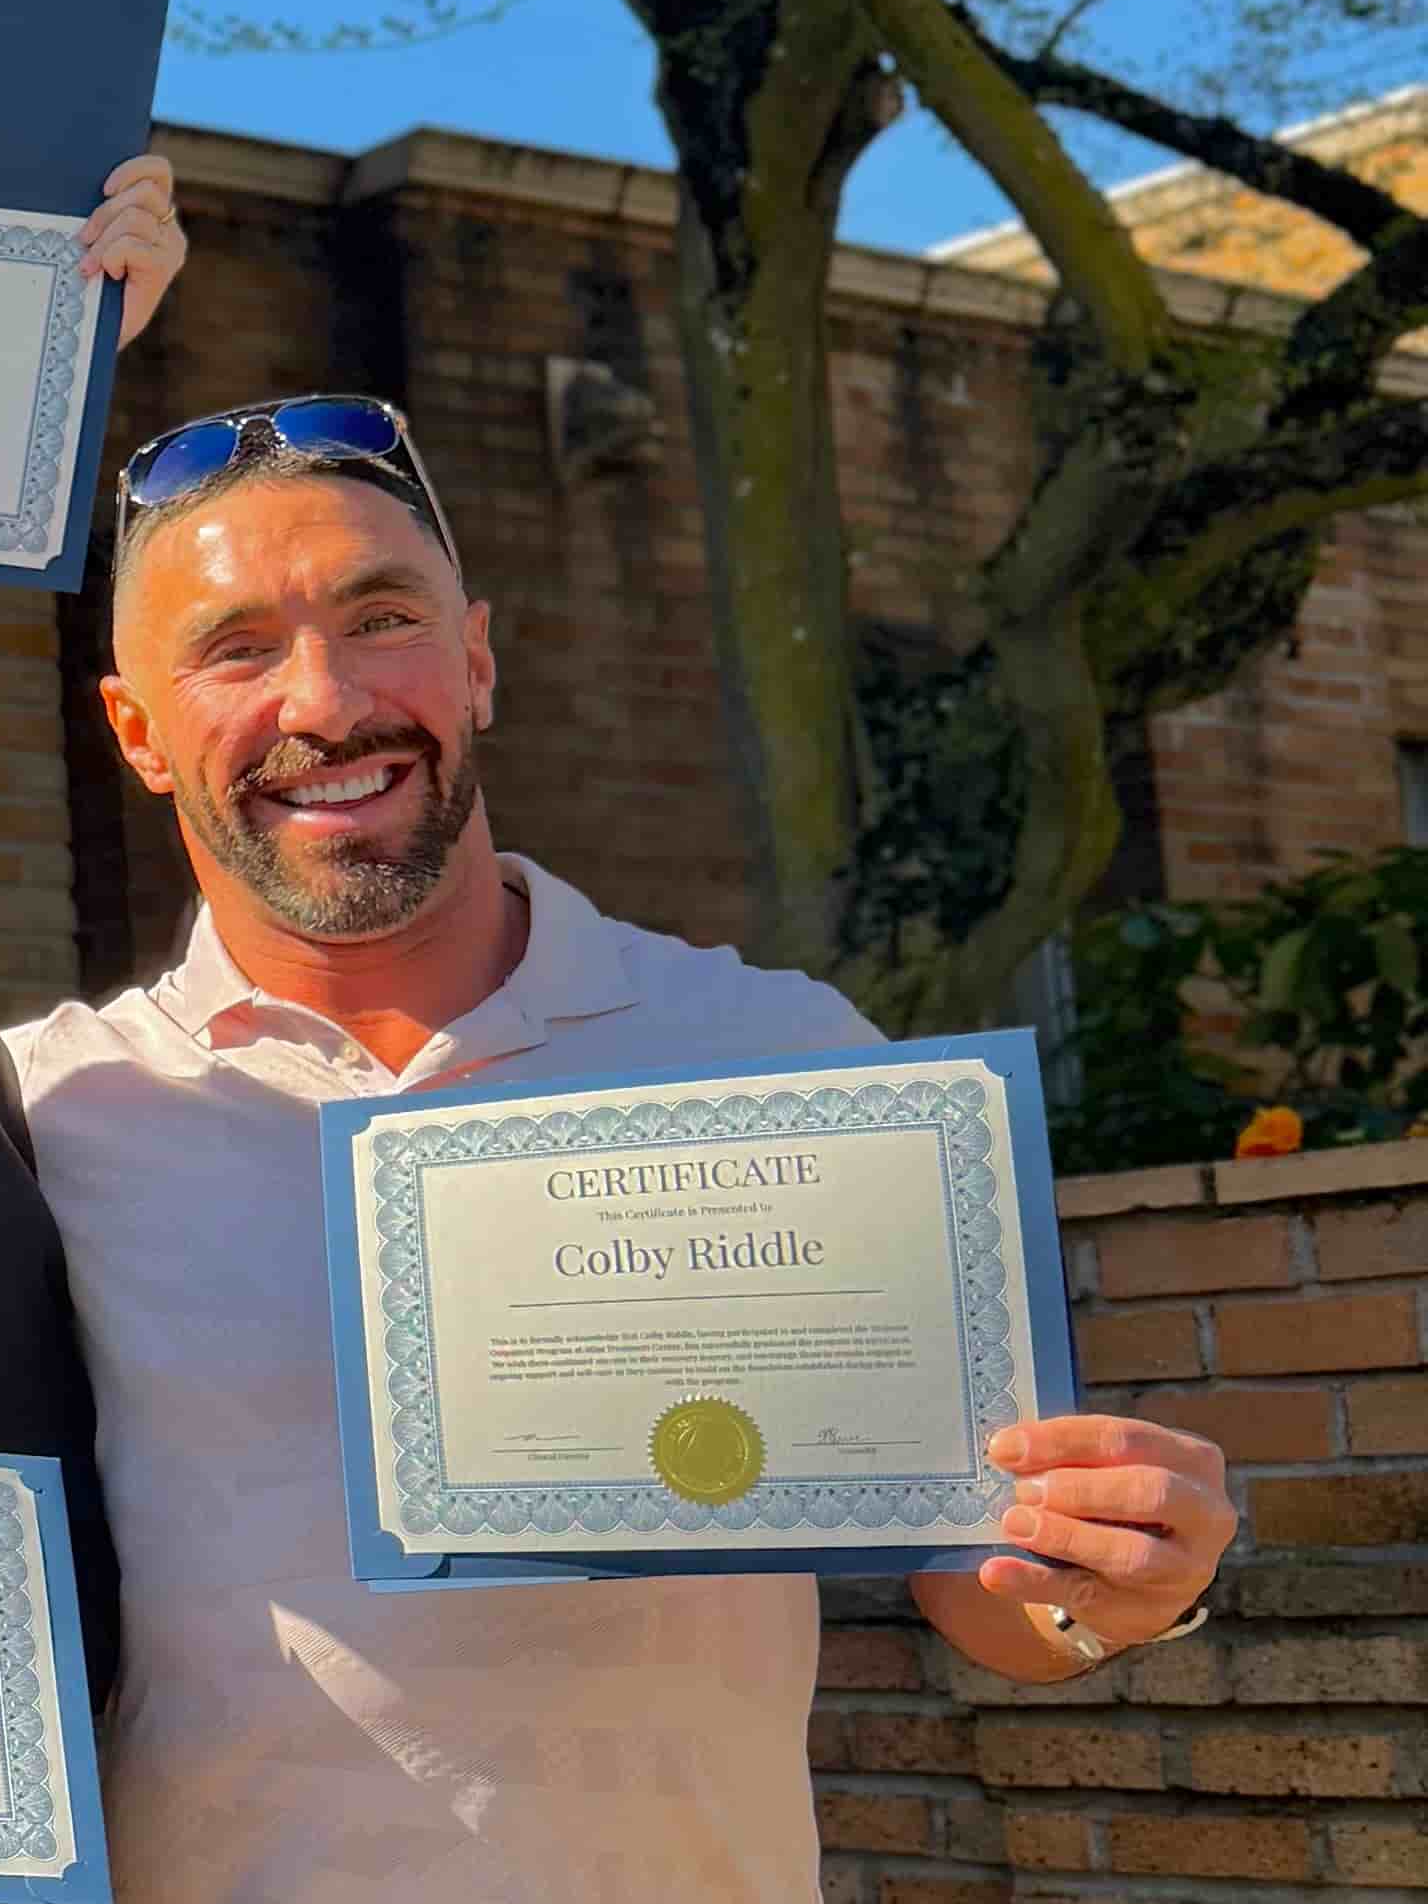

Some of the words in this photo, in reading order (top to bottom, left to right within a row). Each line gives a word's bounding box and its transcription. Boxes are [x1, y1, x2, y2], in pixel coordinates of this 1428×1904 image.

[546, 1154, 821, 1201] CERTIFICATE
[554, 1238, 675, 1280] Colby
[687, 1230, 825, 1271] Riddle
